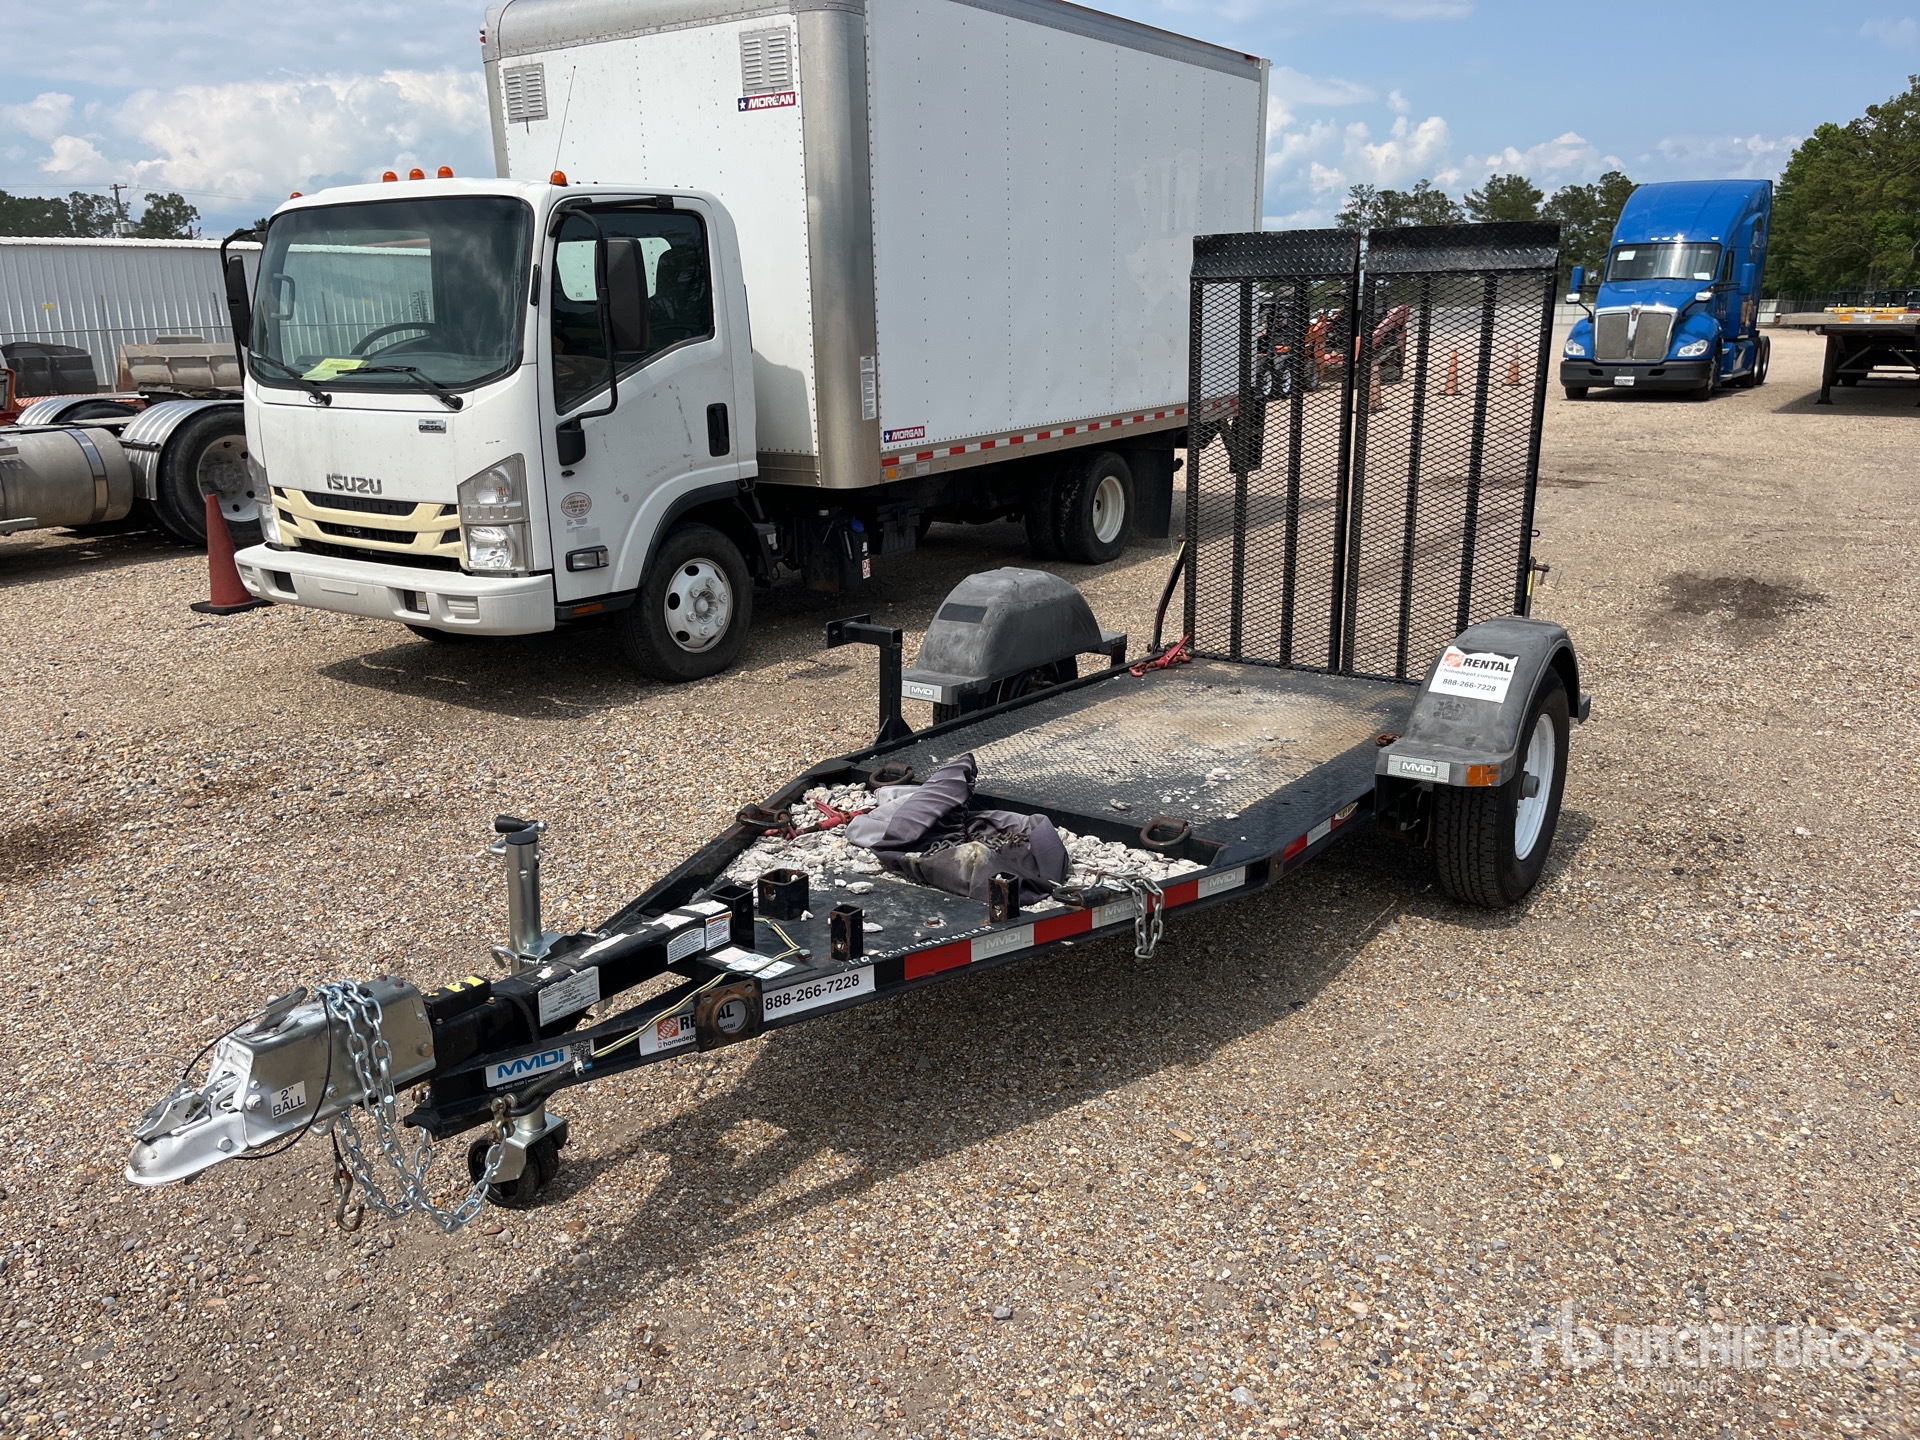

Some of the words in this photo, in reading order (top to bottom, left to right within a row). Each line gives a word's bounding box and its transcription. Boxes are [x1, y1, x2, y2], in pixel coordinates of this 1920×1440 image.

[748, 94, 794, 109] MORGAN
[891, 427, 924, 441] MORGAN
[326, 473, 383, 495] ISUZU
[1463, 658, 1512, 673] RENTAL
[1442, 678, 1497, 692] 888-266-7228
[1402, 762, 1436, 774] MMDi
[985, 931, 1021, 950] MMDi
[765, 974, 860, 1011] 888-266-7228
[680, 1004, 734, 1031] REAL
[497, 1048, 565, 1079] MMDi
[273, 1096, 305, 1116] BALL
